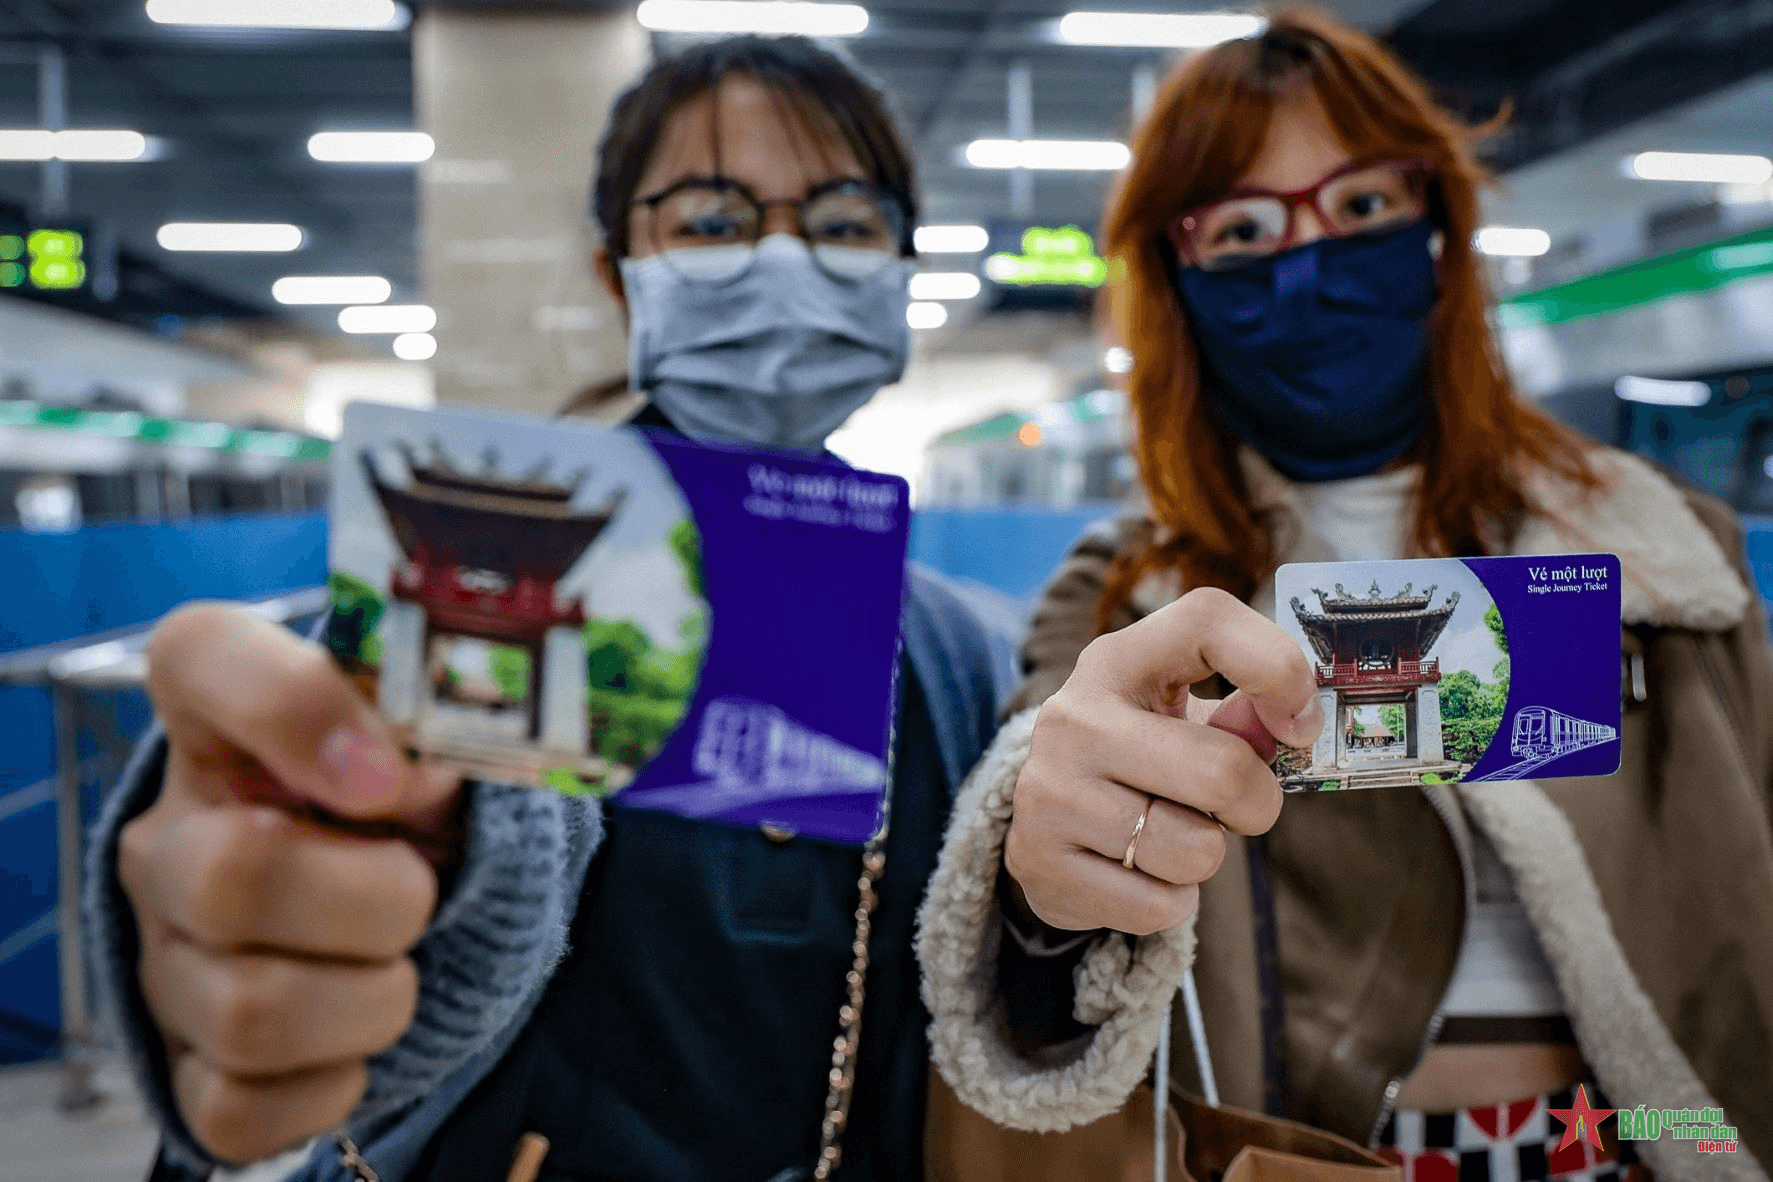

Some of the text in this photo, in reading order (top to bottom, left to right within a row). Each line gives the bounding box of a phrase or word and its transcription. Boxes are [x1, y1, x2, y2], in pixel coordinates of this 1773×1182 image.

[1528, 565, 1608, 582] Vé một lượt
[1527, 581, 1608, 595] Single Journey Ticket
